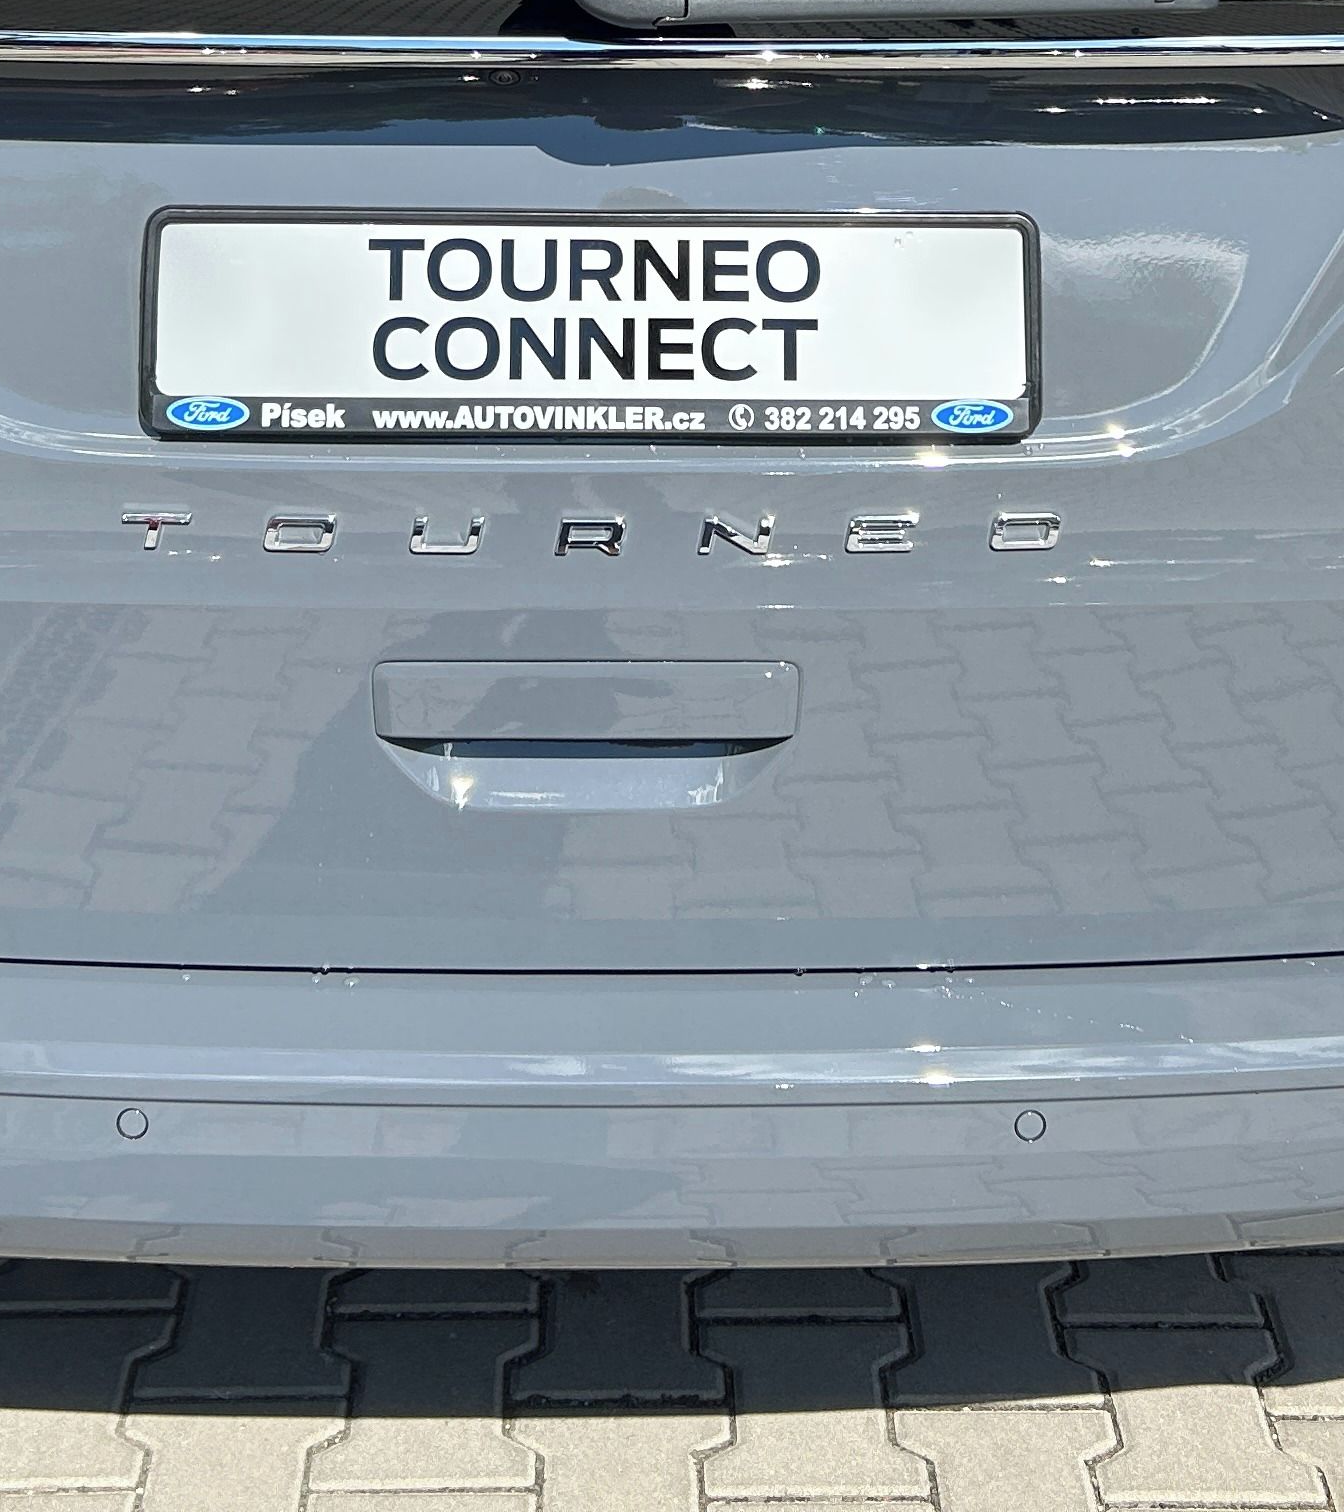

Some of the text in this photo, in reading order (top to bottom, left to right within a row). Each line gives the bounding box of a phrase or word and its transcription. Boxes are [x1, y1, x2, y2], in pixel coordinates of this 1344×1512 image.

[368, 238, 821, 303] TOURNEO
[373, 316, 819, 381] CONNECT
[261, 402, 921, 431] Písek www.AUTOVINKLER.cz 382 214 295
[121, 511, 1063, 557] TOURNEO
